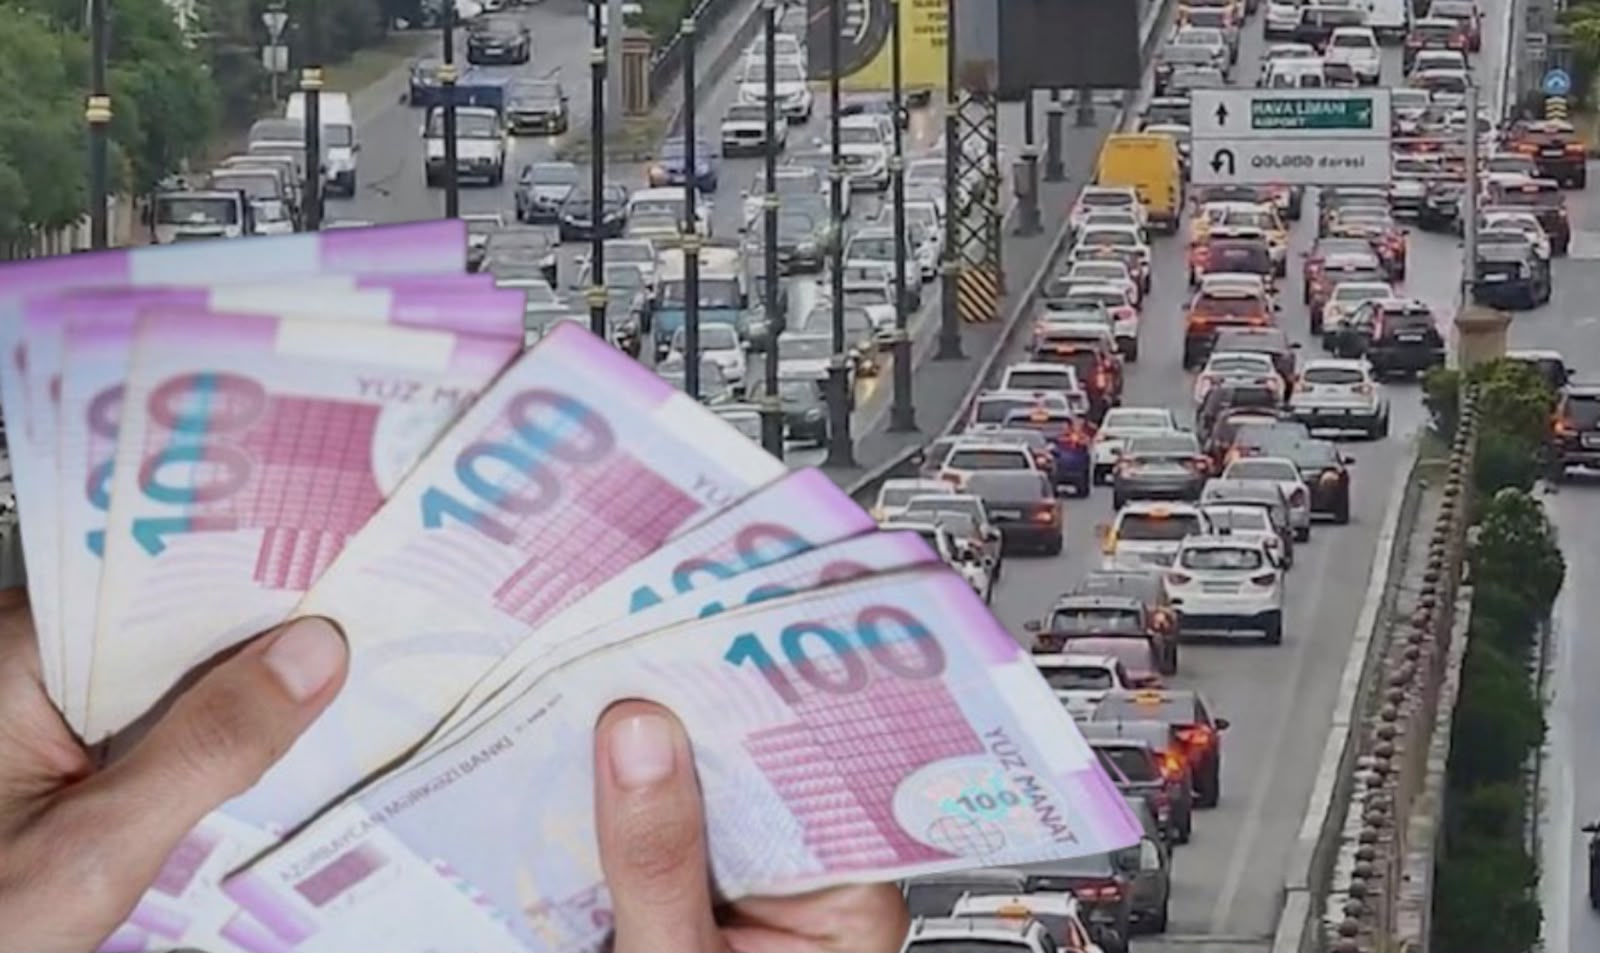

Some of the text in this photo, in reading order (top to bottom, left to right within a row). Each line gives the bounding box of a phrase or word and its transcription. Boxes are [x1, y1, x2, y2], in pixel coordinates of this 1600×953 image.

[1253, 102, 1293, 115] HAVA
[1254, 117, 1306, 127] AIRPORT
[132, 372, 266, 557] 100
[420, 388, 617, 546] 100
[723, 604, 947, 708] 100
[956, 790, 1020, 813] 100
[1012, 775, 1079, 845] MANAT
